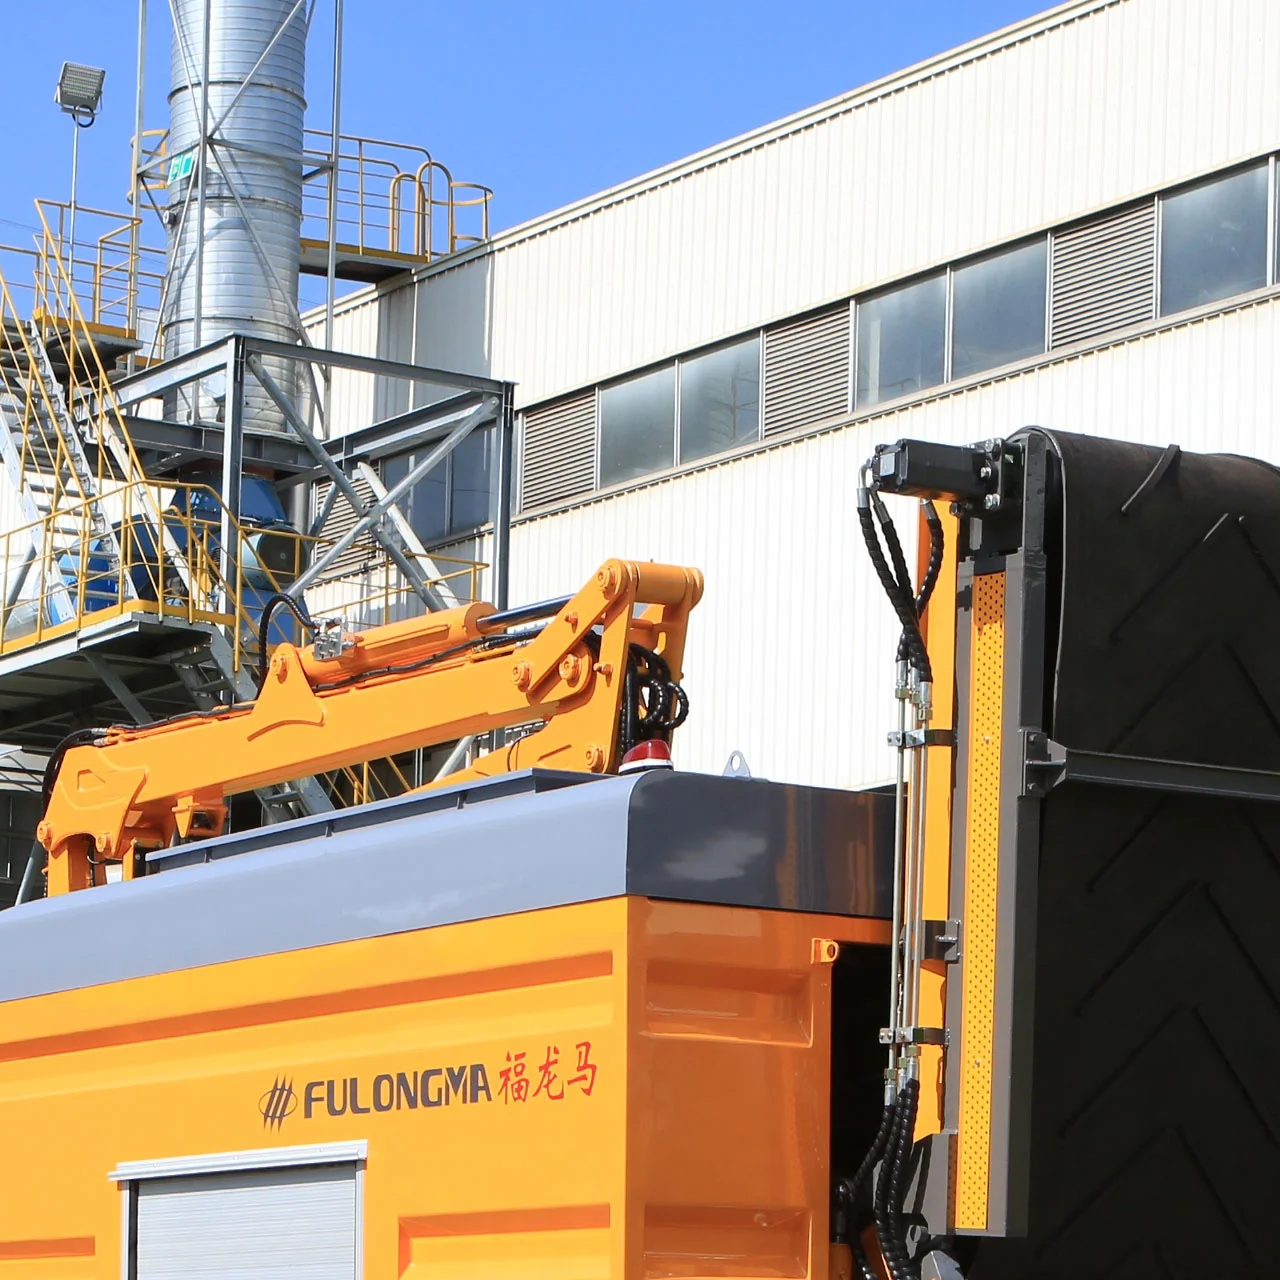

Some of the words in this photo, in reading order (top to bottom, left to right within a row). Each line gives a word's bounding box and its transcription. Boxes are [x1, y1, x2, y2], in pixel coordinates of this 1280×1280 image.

[304, 1063, 492, 1119] FULONGMA
[497, 1041, 597, 1105] 福龙马
